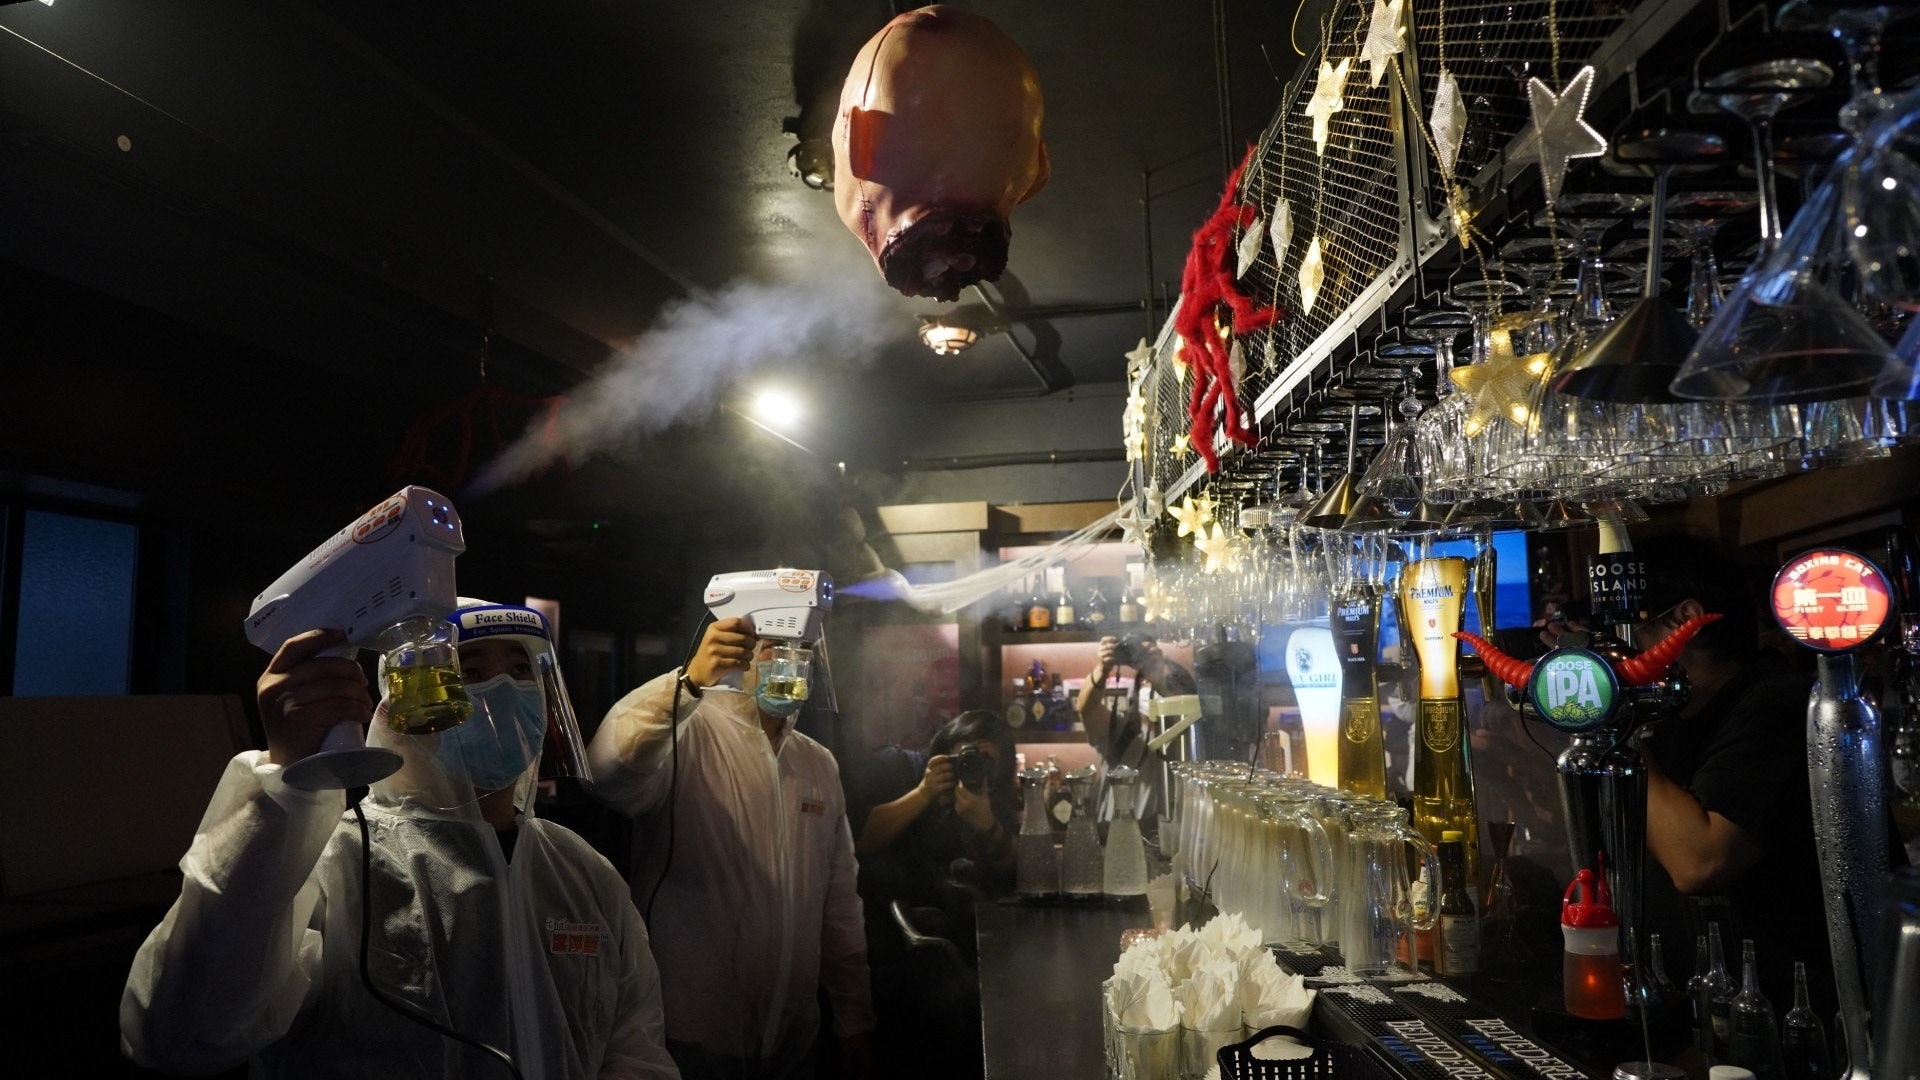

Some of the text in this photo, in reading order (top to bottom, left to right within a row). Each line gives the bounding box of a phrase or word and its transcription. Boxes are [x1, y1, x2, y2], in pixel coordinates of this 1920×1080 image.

[1588, 562, 1646, 578] GOOSE
[1844, 558, 1873, 577] CAT
[1410, 584, 1454, 600] PREMIUM
[1337, 605, 1370, 617] PREMIUM
[474, 612, 537, 625] Face Shield
[473, 628, 486, 636] For
[1546, 660, 1593, 671] GOOSE
[1546, 669, 1603, 709] IPA
[1424, 705, 1455, 714] PREMIUM
